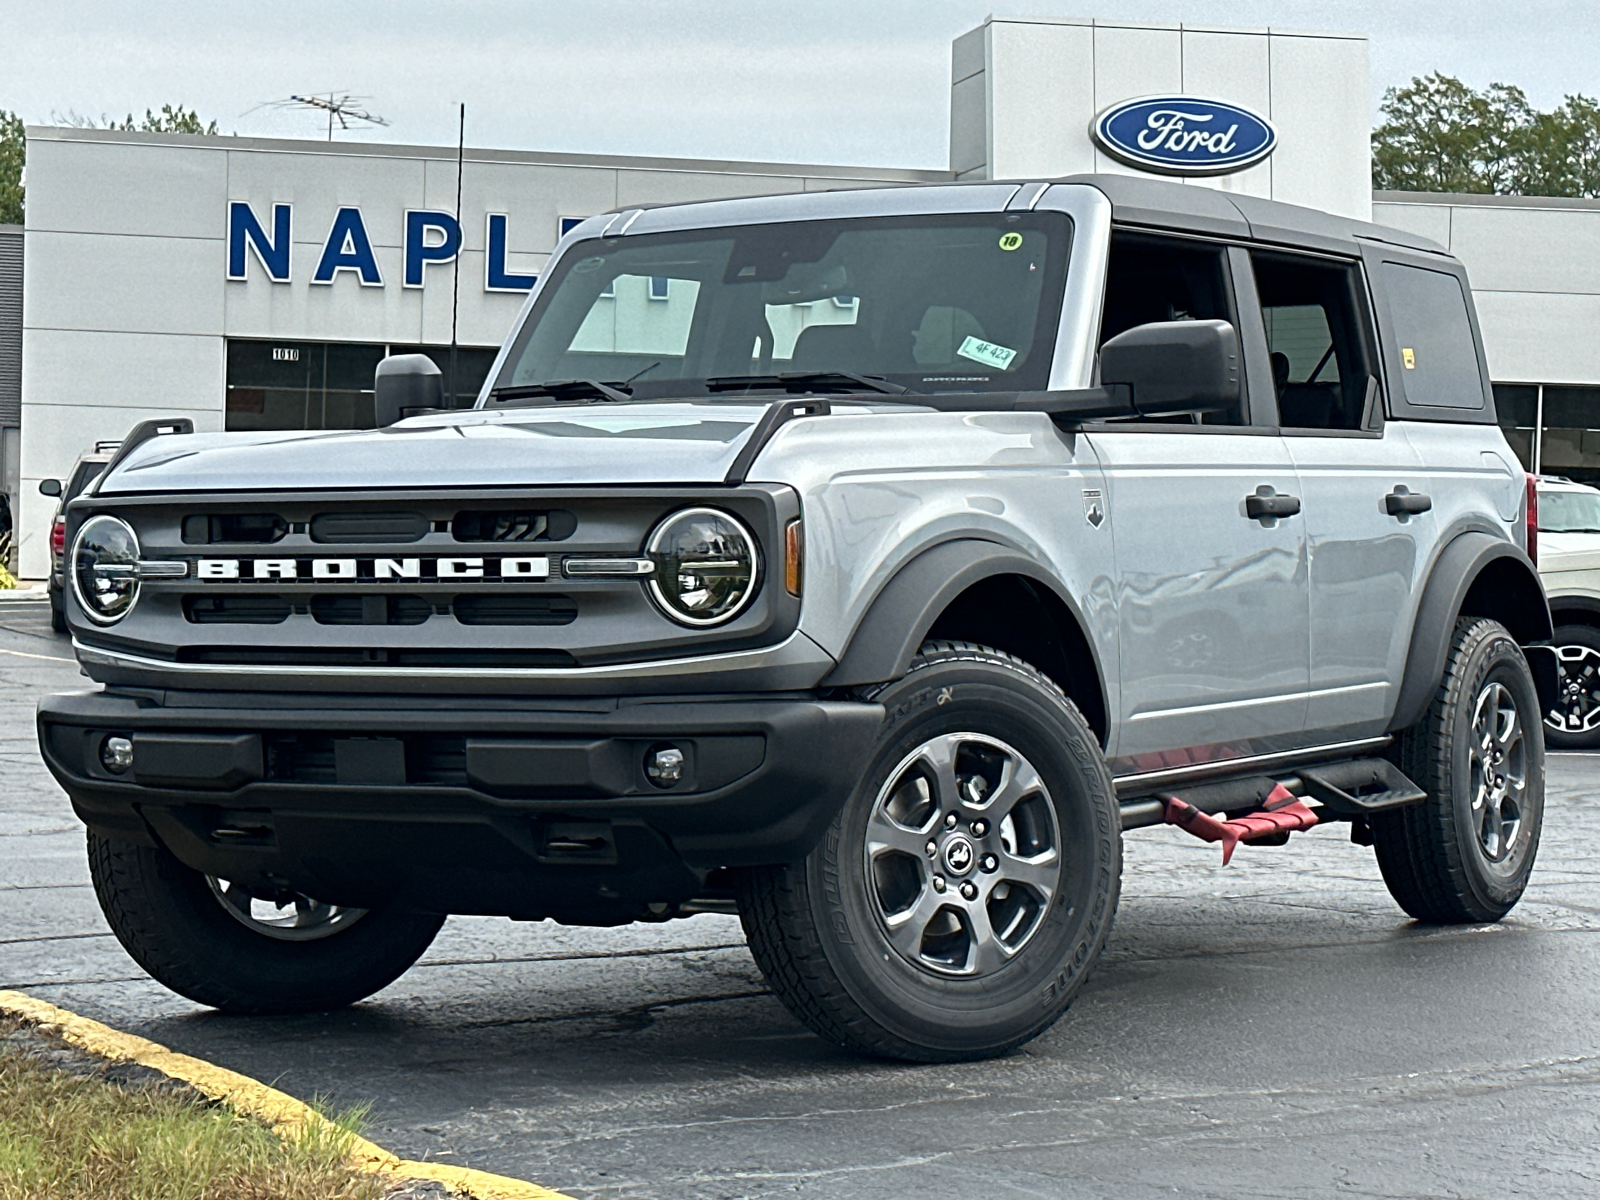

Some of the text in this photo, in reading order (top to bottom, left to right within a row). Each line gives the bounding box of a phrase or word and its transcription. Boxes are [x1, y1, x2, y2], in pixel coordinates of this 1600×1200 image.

[1137, 109, 1239, 154] Ford
[226, 200, 587, 293] NAPL
[274, 348, 298, 360] 1010
[197, 556, 550, 579] BRONCO
